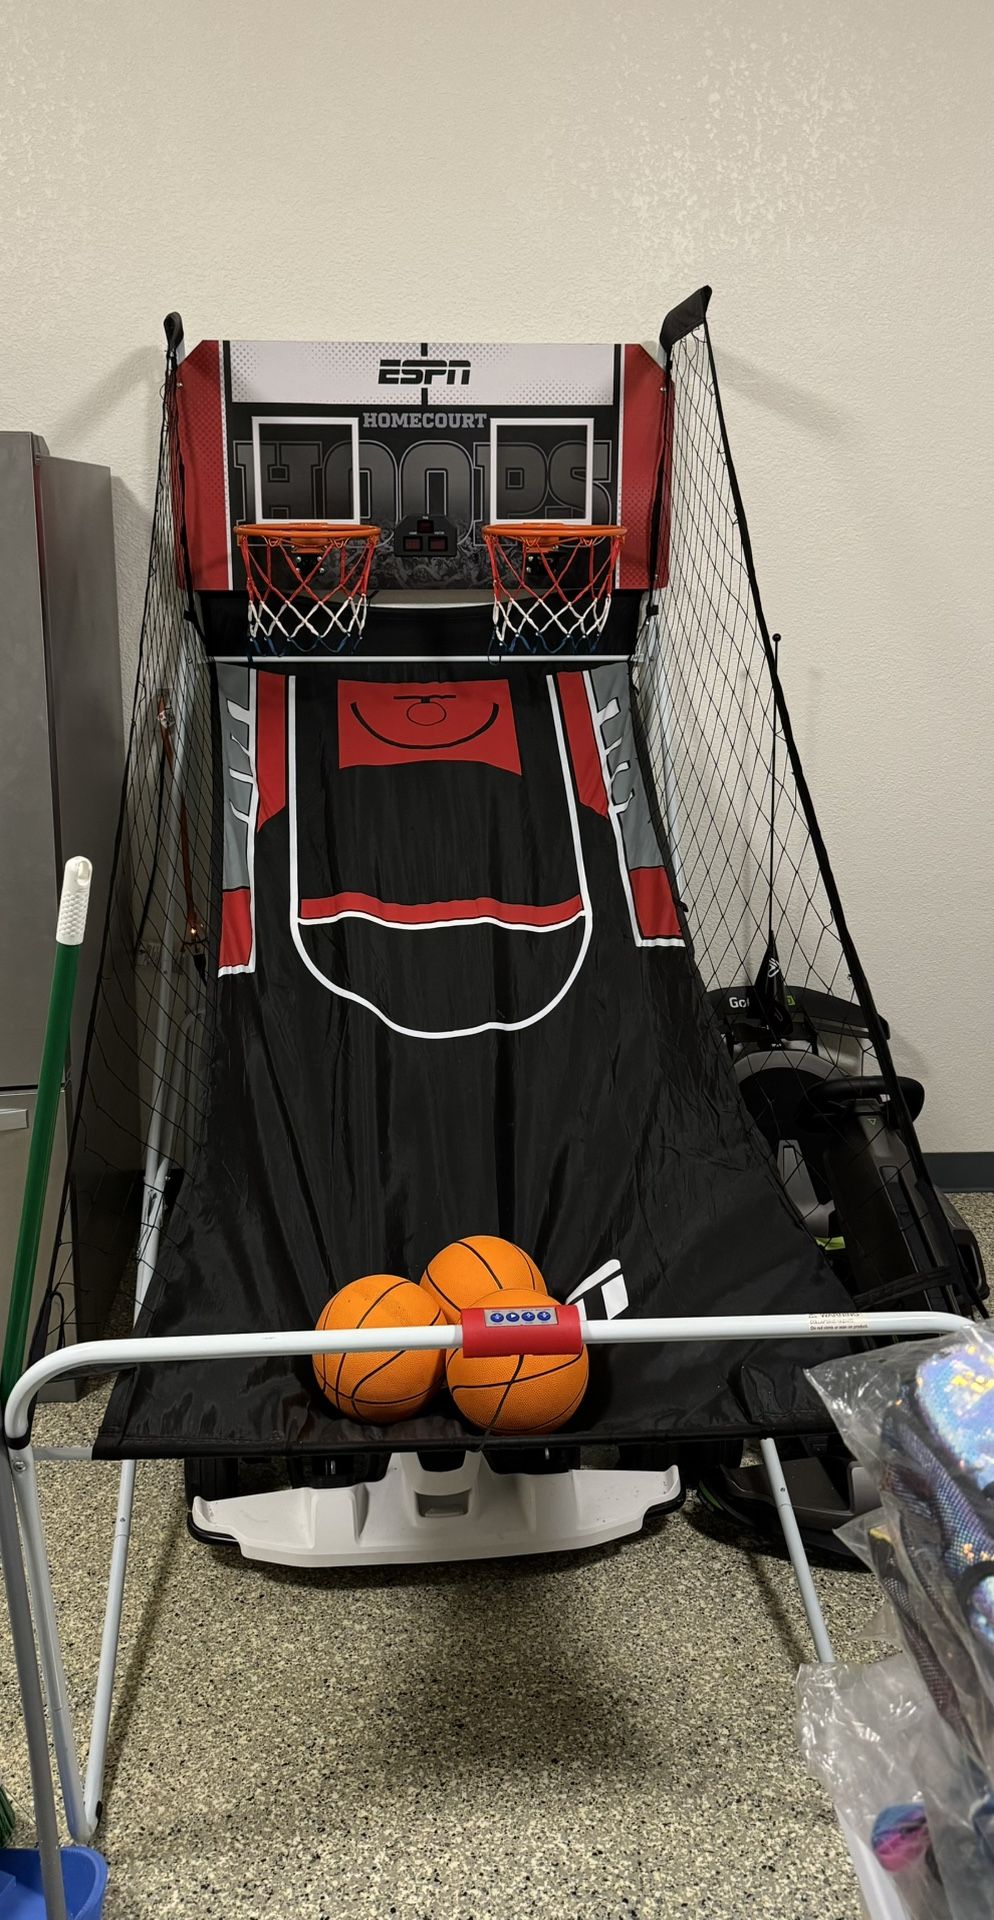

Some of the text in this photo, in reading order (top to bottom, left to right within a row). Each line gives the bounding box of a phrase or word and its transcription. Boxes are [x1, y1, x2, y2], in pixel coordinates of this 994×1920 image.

[377, 358, 472, 386] ESPN
[362, 412, 488, 429] HOMECOURT
[232, 439, 613, 547] HOOPS
